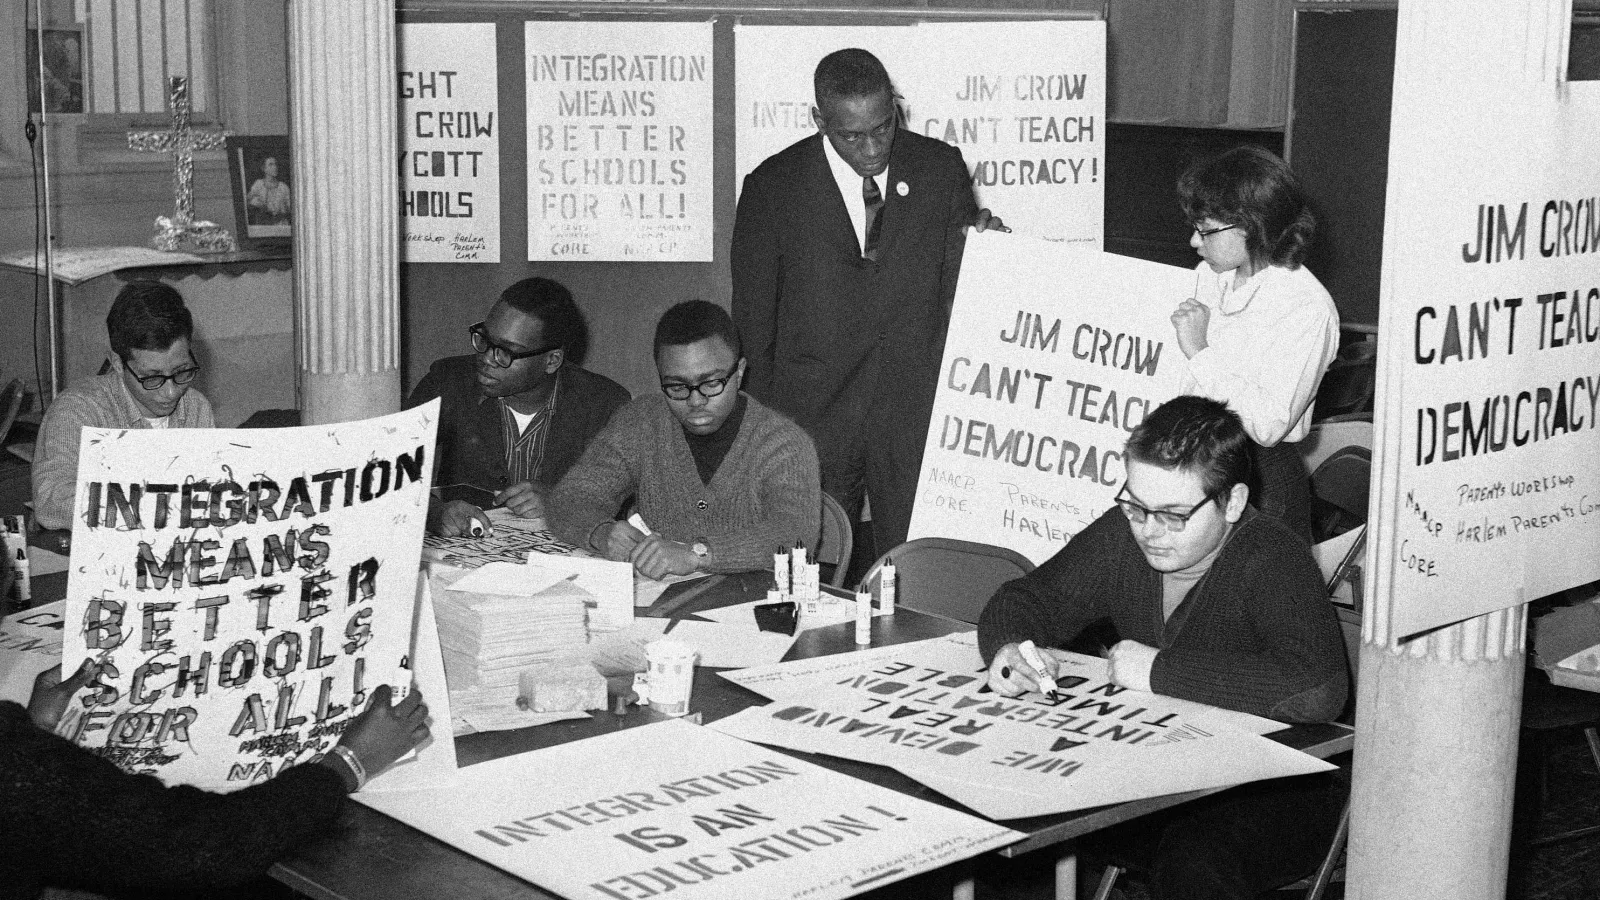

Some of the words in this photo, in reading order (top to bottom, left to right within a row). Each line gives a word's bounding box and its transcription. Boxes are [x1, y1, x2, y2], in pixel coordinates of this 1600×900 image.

[398, 71, 457, 99] GHT
[531, 53, 706, 82] INTEGRATION
[956, 75, 1001, 101] JIM
[1014, 74, 1088, 101] CROW
[416, 111, 494, 138] CROW
[558, 89, 656, 117] MEANS
[537, 124, 687, 151] BETTER
[924, 117, 1002, 143] CAN'T
[1014, 116, 1094, 142] TEACH
[538, 158, 688, 186] SCHOOLS
[541, 193, 600, 219] FOR
[620, 192, 686, 219] ALL!
[551, 242, 590, 255] CORE
[1462, 202, 1528, 264] JIM
[1000, 310, 1061, 353] JIM
[1072, 323, 1164, 377] CROW
[1415, 297, 1523, 365] CAN'T
[947, 356, 1052, 409] CAN'T
[85, 445, 425, 530] INTEGRATION
[135, 524, 333, 590] MEANS
[86, 557, 382, 651] BETTER
[83, 606, 374, 707] SCHOOLS
[73, 704, 197, 744] FOR
[229, 657, 366, 736] ALL!
[836, 674, 1156, 744] INTEGRATION
[861, 698, 994, 736] REAL
[772, 706, 982, 756] DEMAND
[1049, 736, 1089, 751] A
[991, 750, 1084, 777] WE
[474, 760, 799, 847] INTEGRATION
[614, 826, 688, 853] IS
[691, 804, 775, 837] AN
